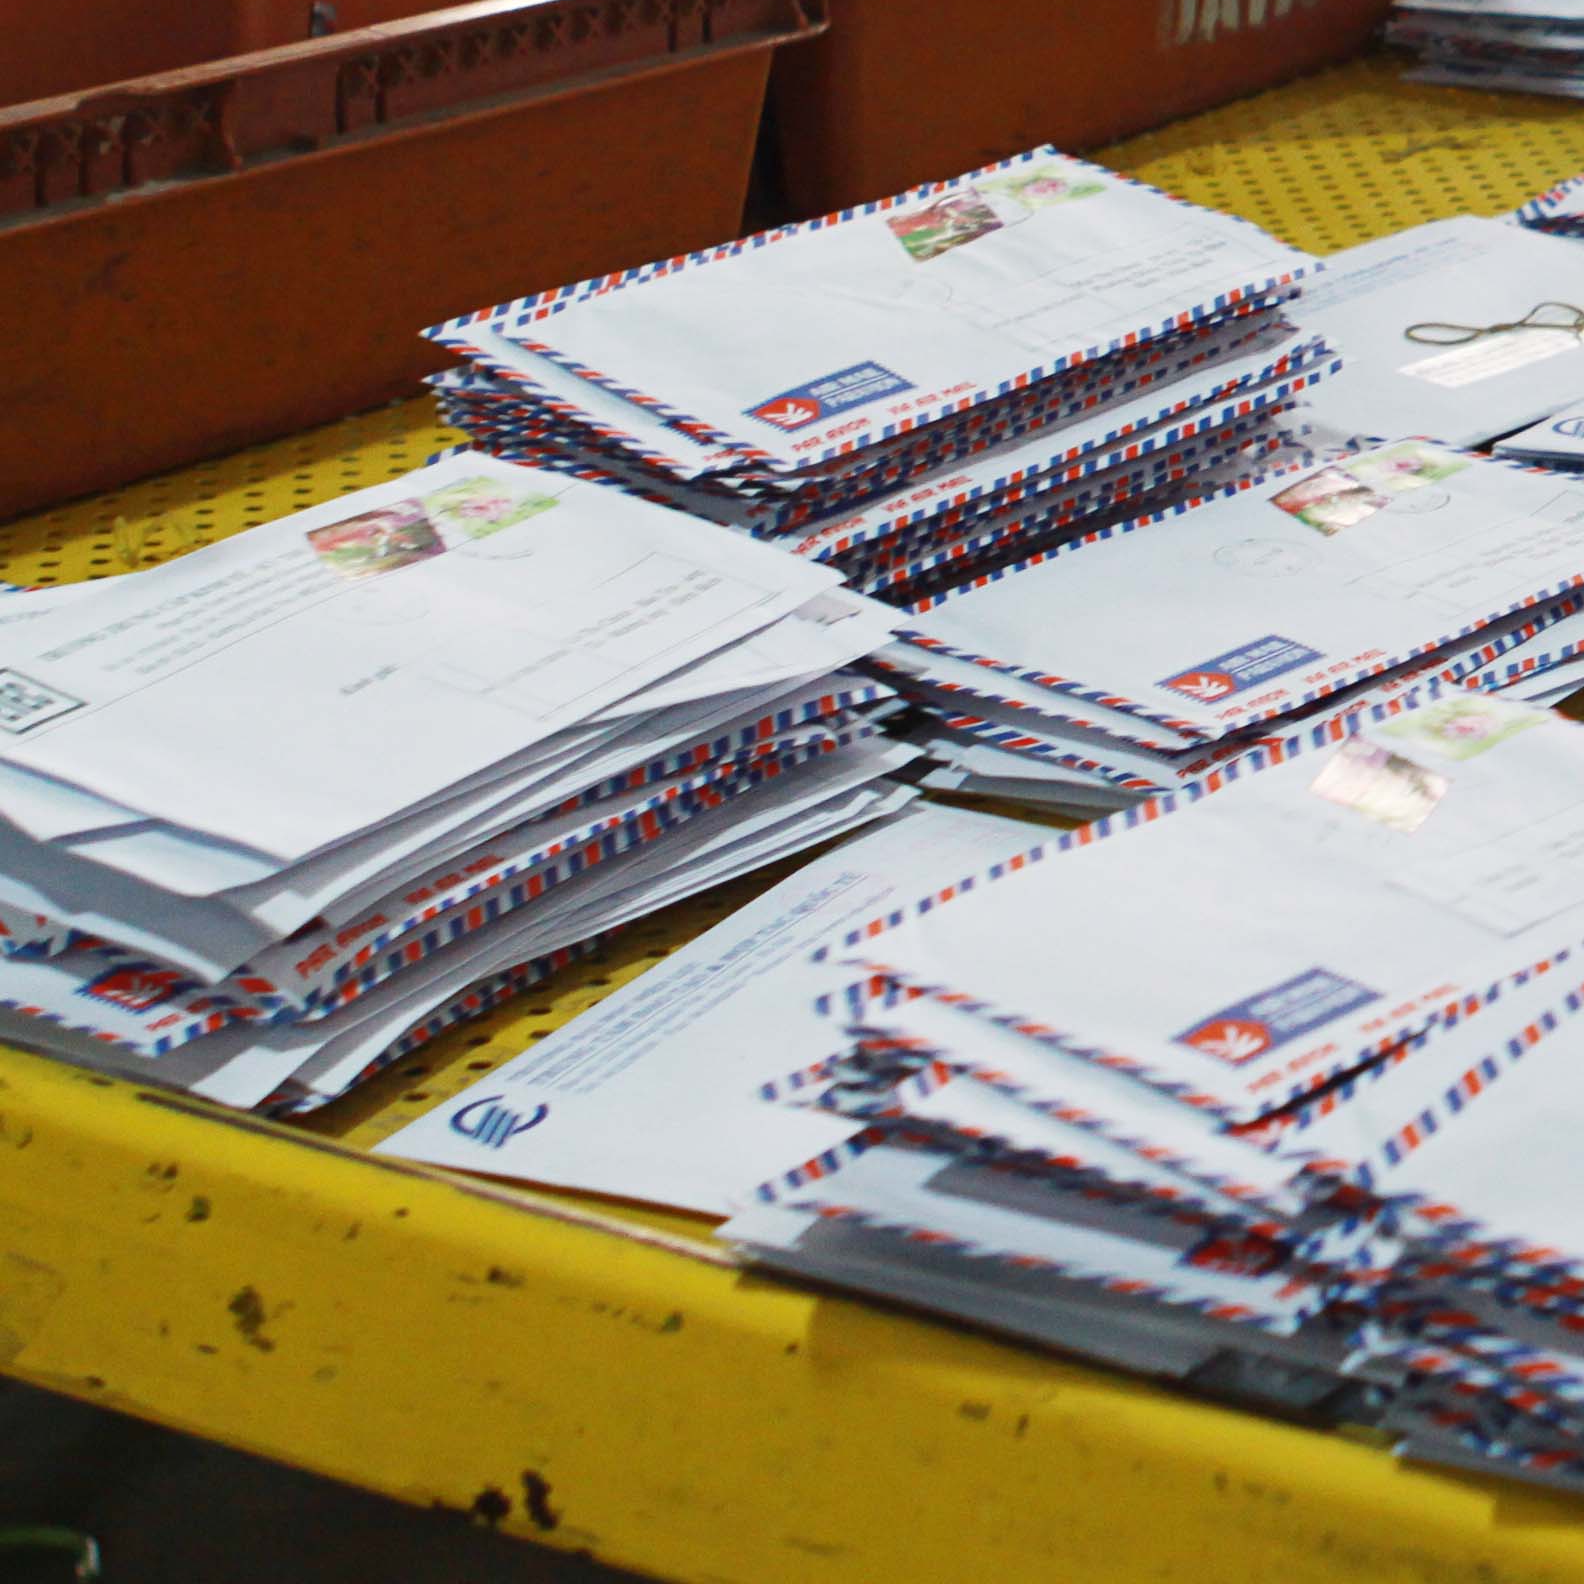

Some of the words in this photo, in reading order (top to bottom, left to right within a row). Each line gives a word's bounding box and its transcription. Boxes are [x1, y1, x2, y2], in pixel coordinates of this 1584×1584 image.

[792, 436, 823, 452] PAR
[826, 417, 870, 440] AVION
[914, 393, 938, 407] AIR
[941, 381, 977, 396] MAIL
[910, 487, 937, 502] AIR
[936, 474, 973, 491] MAIL
